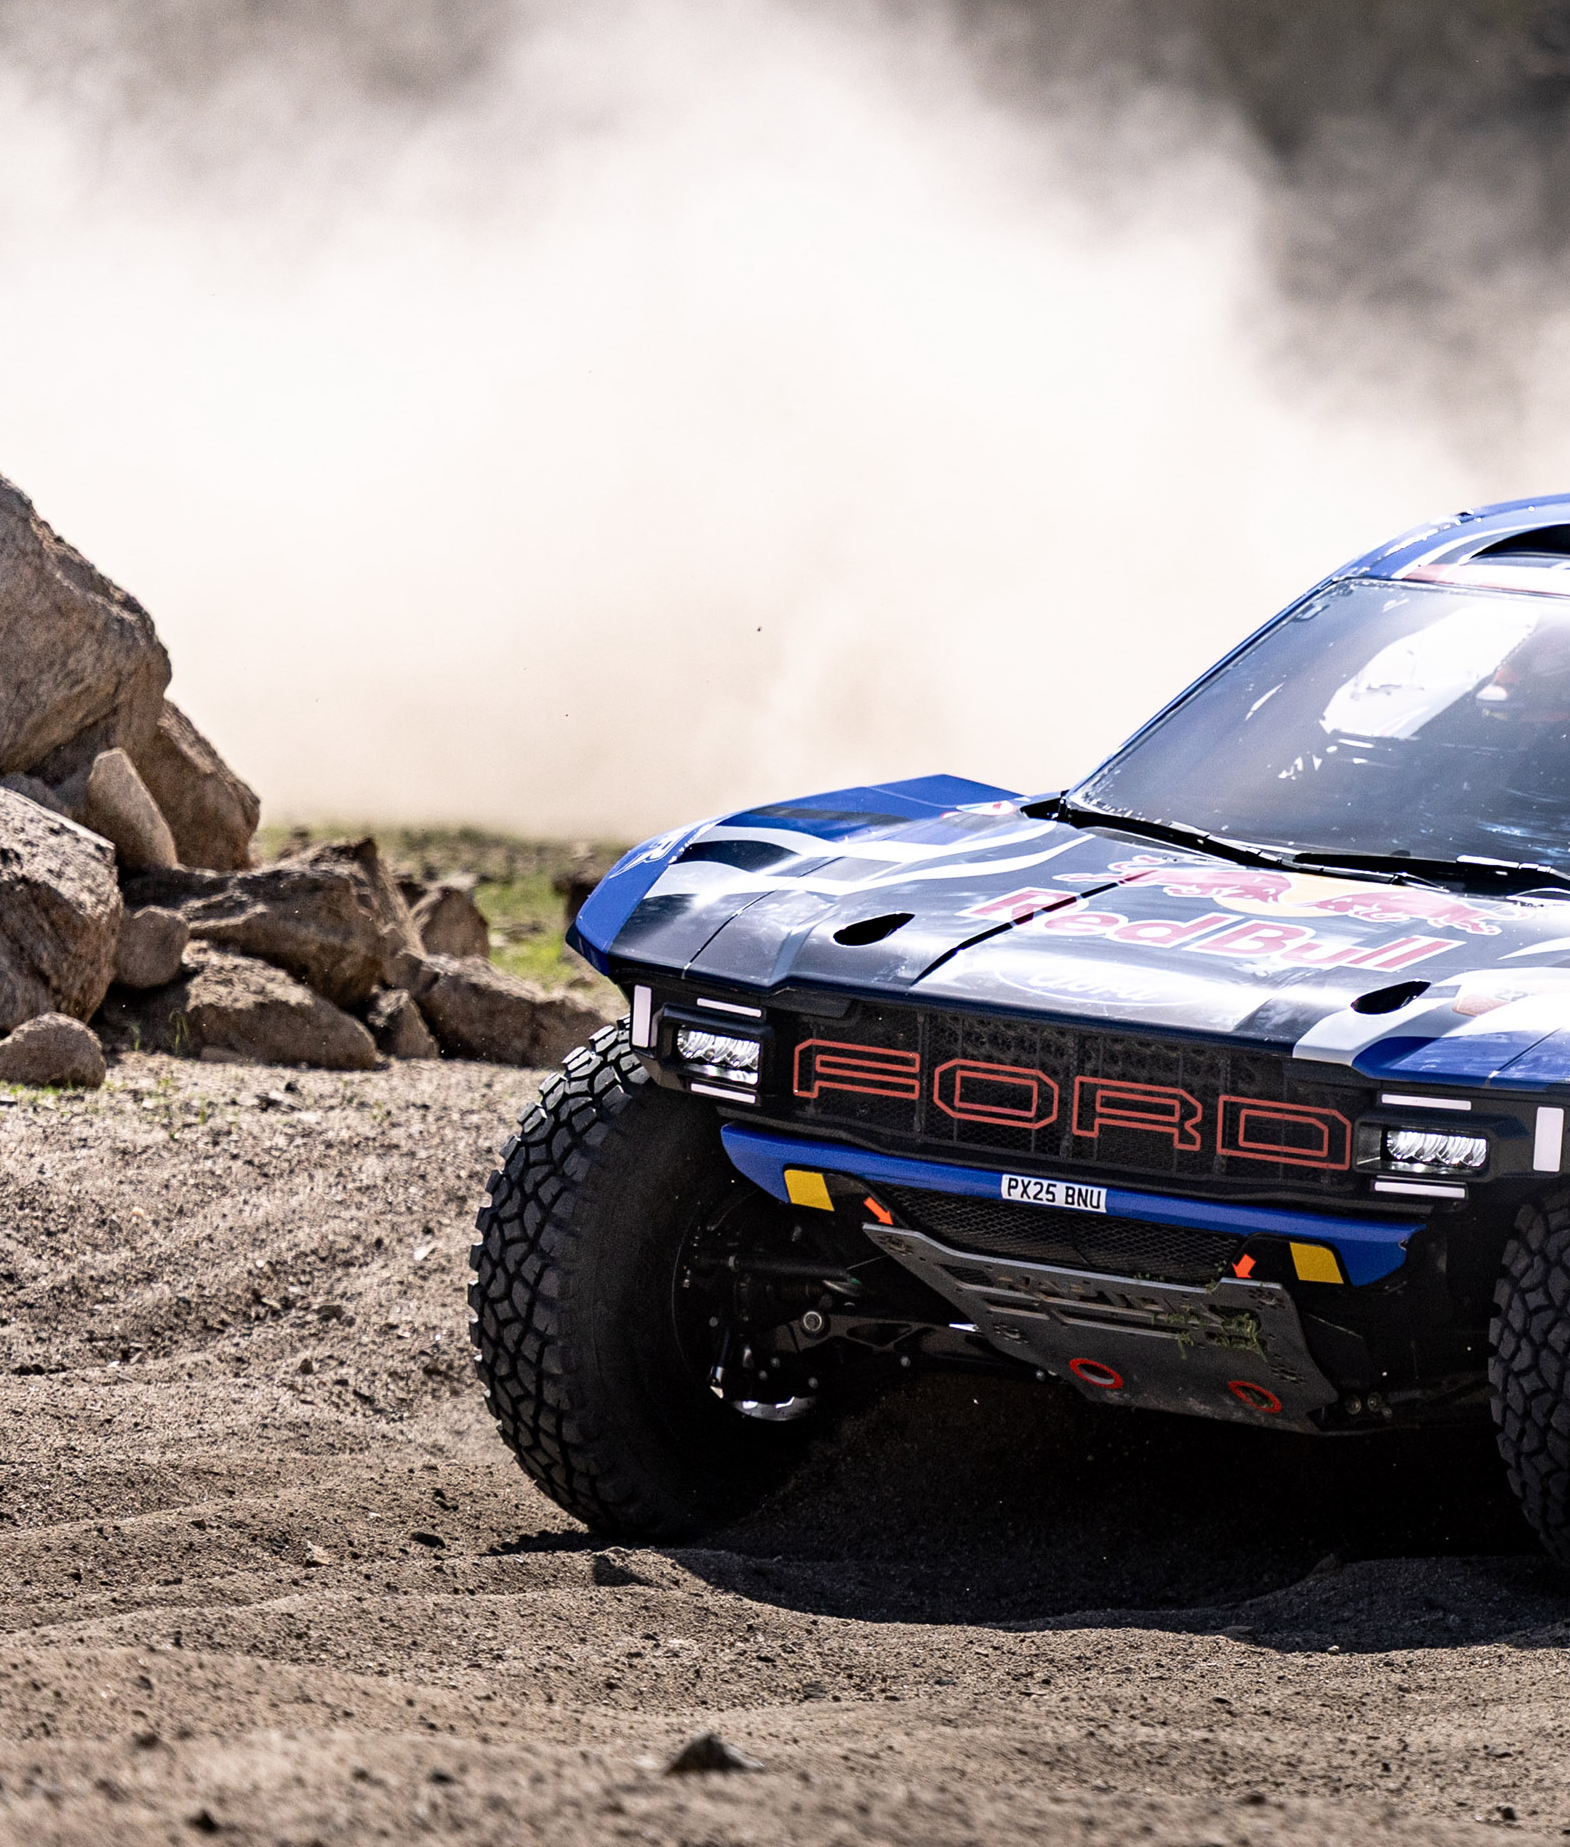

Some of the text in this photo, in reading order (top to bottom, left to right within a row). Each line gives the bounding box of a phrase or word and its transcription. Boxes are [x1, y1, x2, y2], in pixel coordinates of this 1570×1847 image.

[957, 887, 1465, 973] Red Bull
[793, 1038, 1352, 1171] FORD
[1008, 1177, 1101, 1210] PX25 BNU
